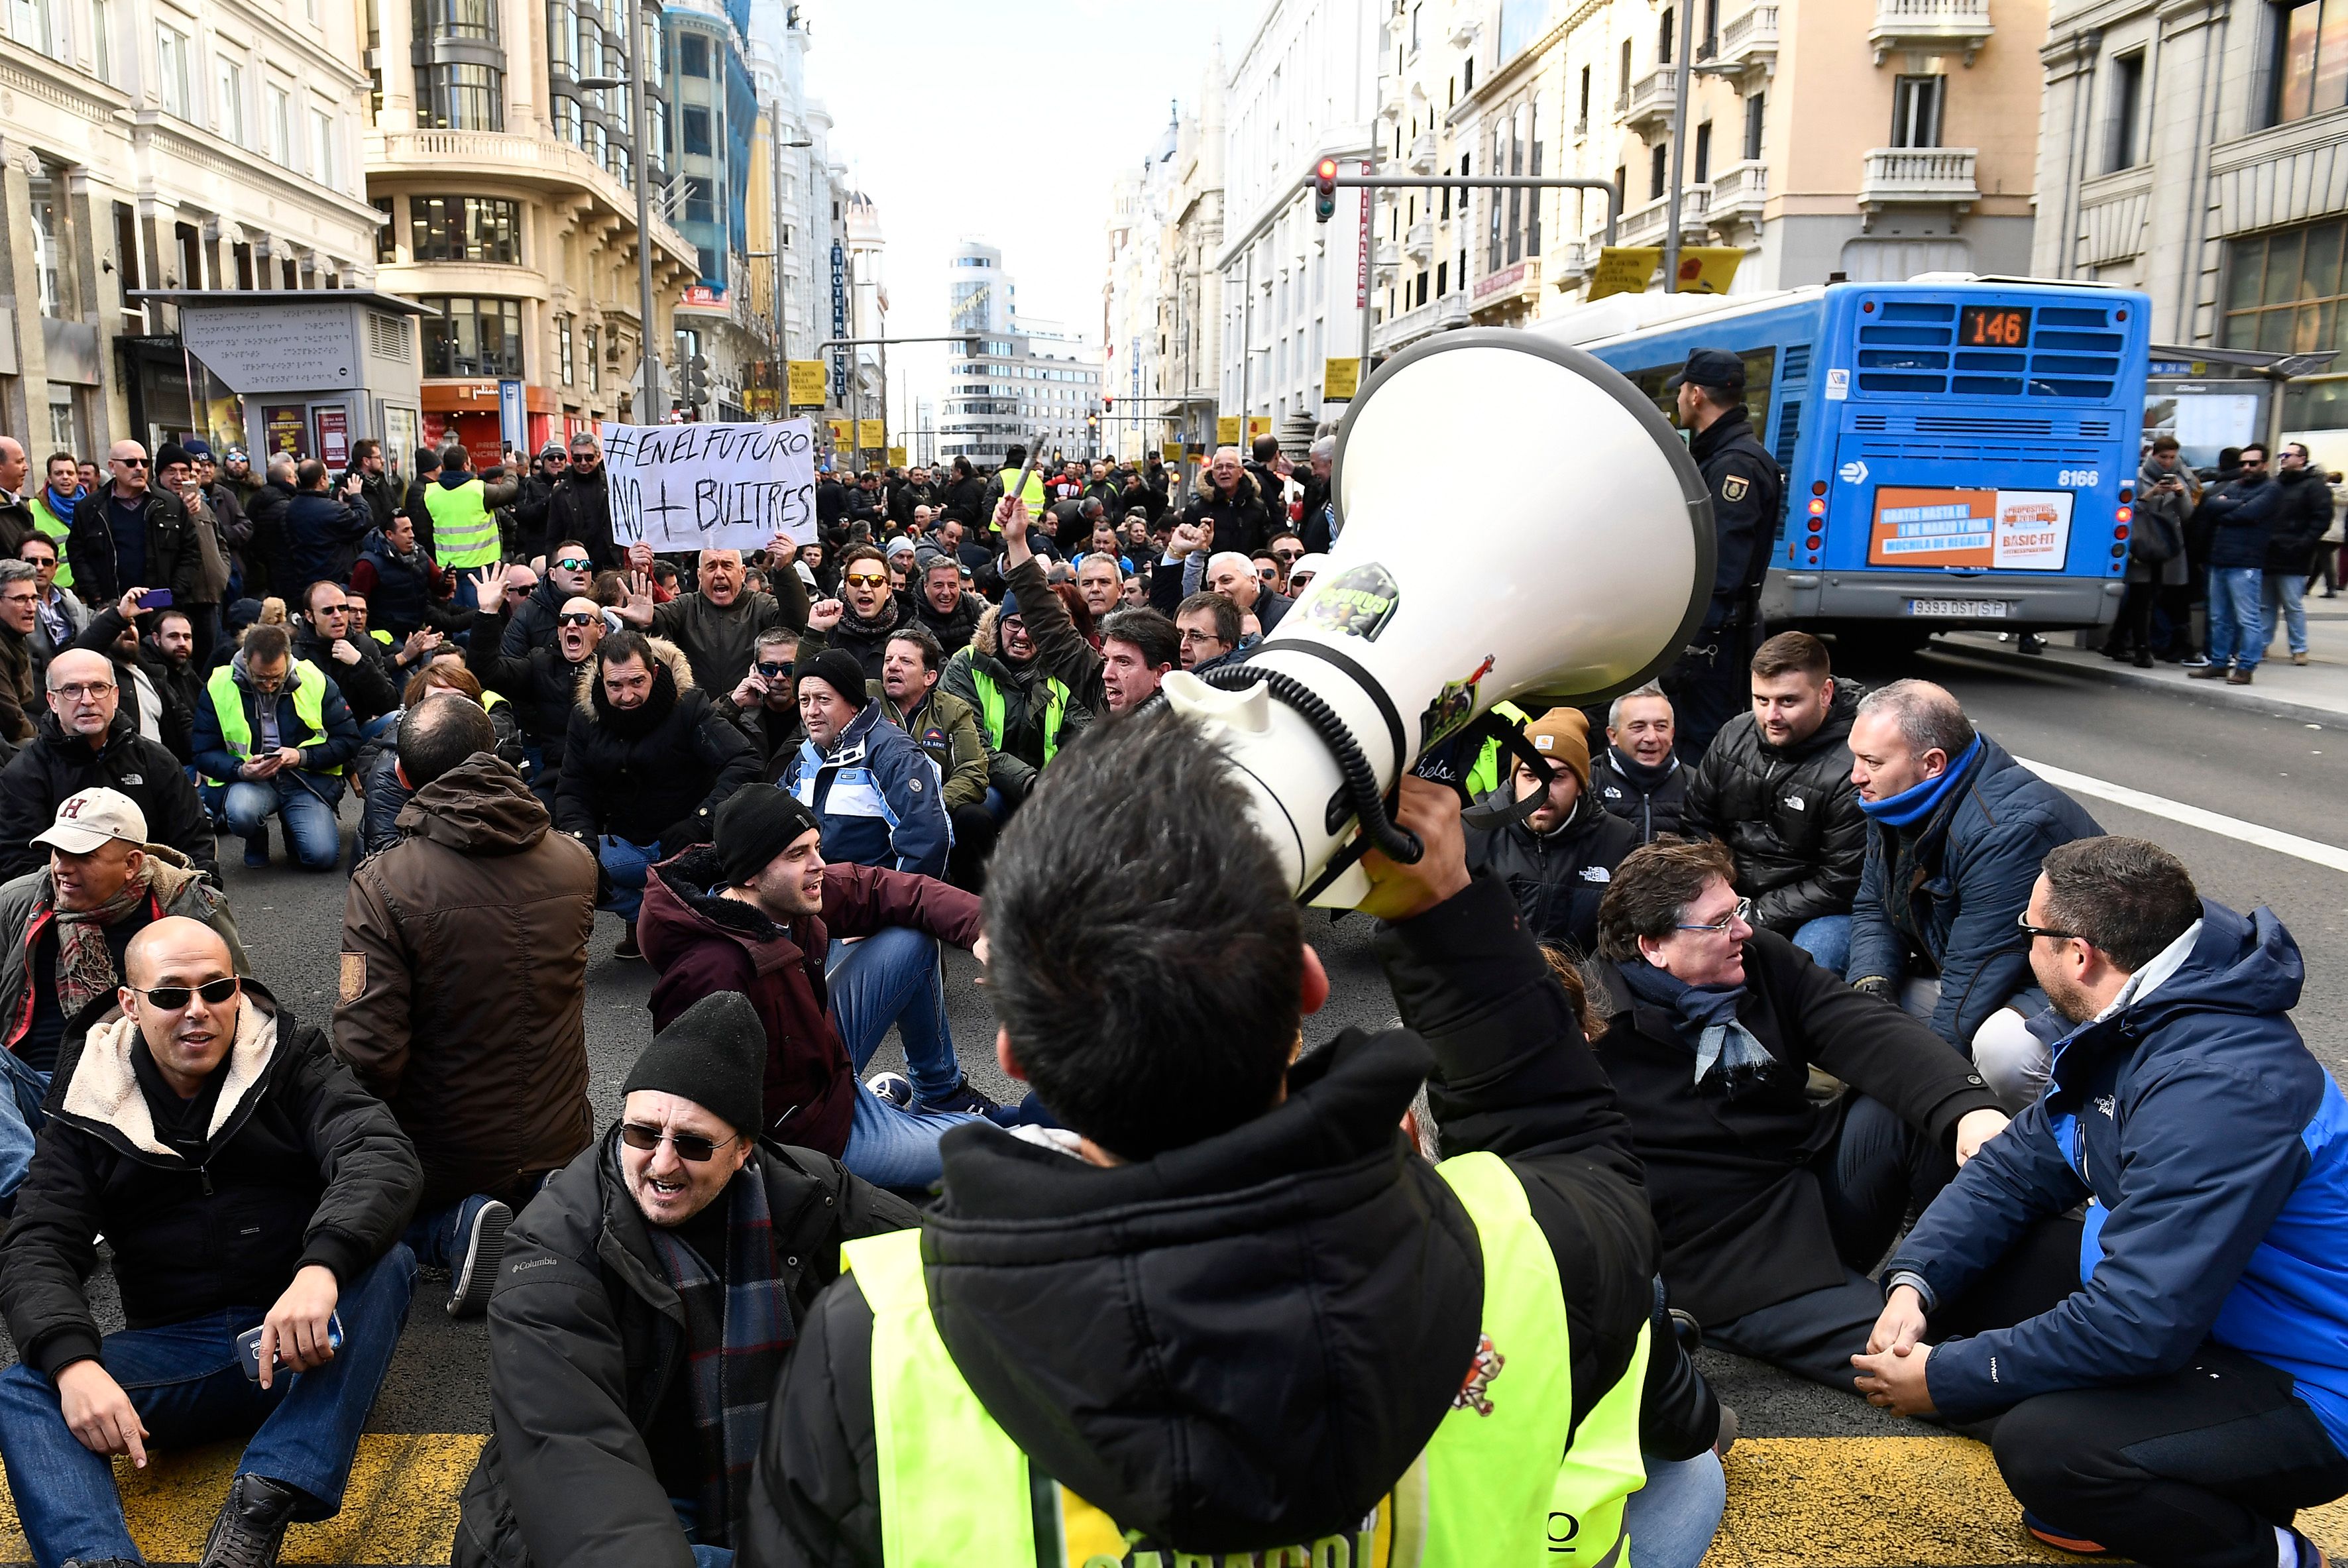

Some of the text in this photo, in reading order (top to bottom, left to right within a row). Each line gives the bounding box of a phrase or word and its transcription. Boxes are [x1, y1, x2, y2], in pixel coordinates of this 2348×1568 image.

[1359, 164, 1370, 284] PTIT PALACE
[832, 264, 845, 395] HOTEL REGENTE
[1972, 311, 2021, 344] 146
[2058, 471, 2098, 486] 8166
[611, 473, 814, 542] NO + BUITRES
[1917, 601, 1976, 614] 9393 DST
[60, 798, 87, 819] H
[520, 1257, 557, 1270] Columbia
